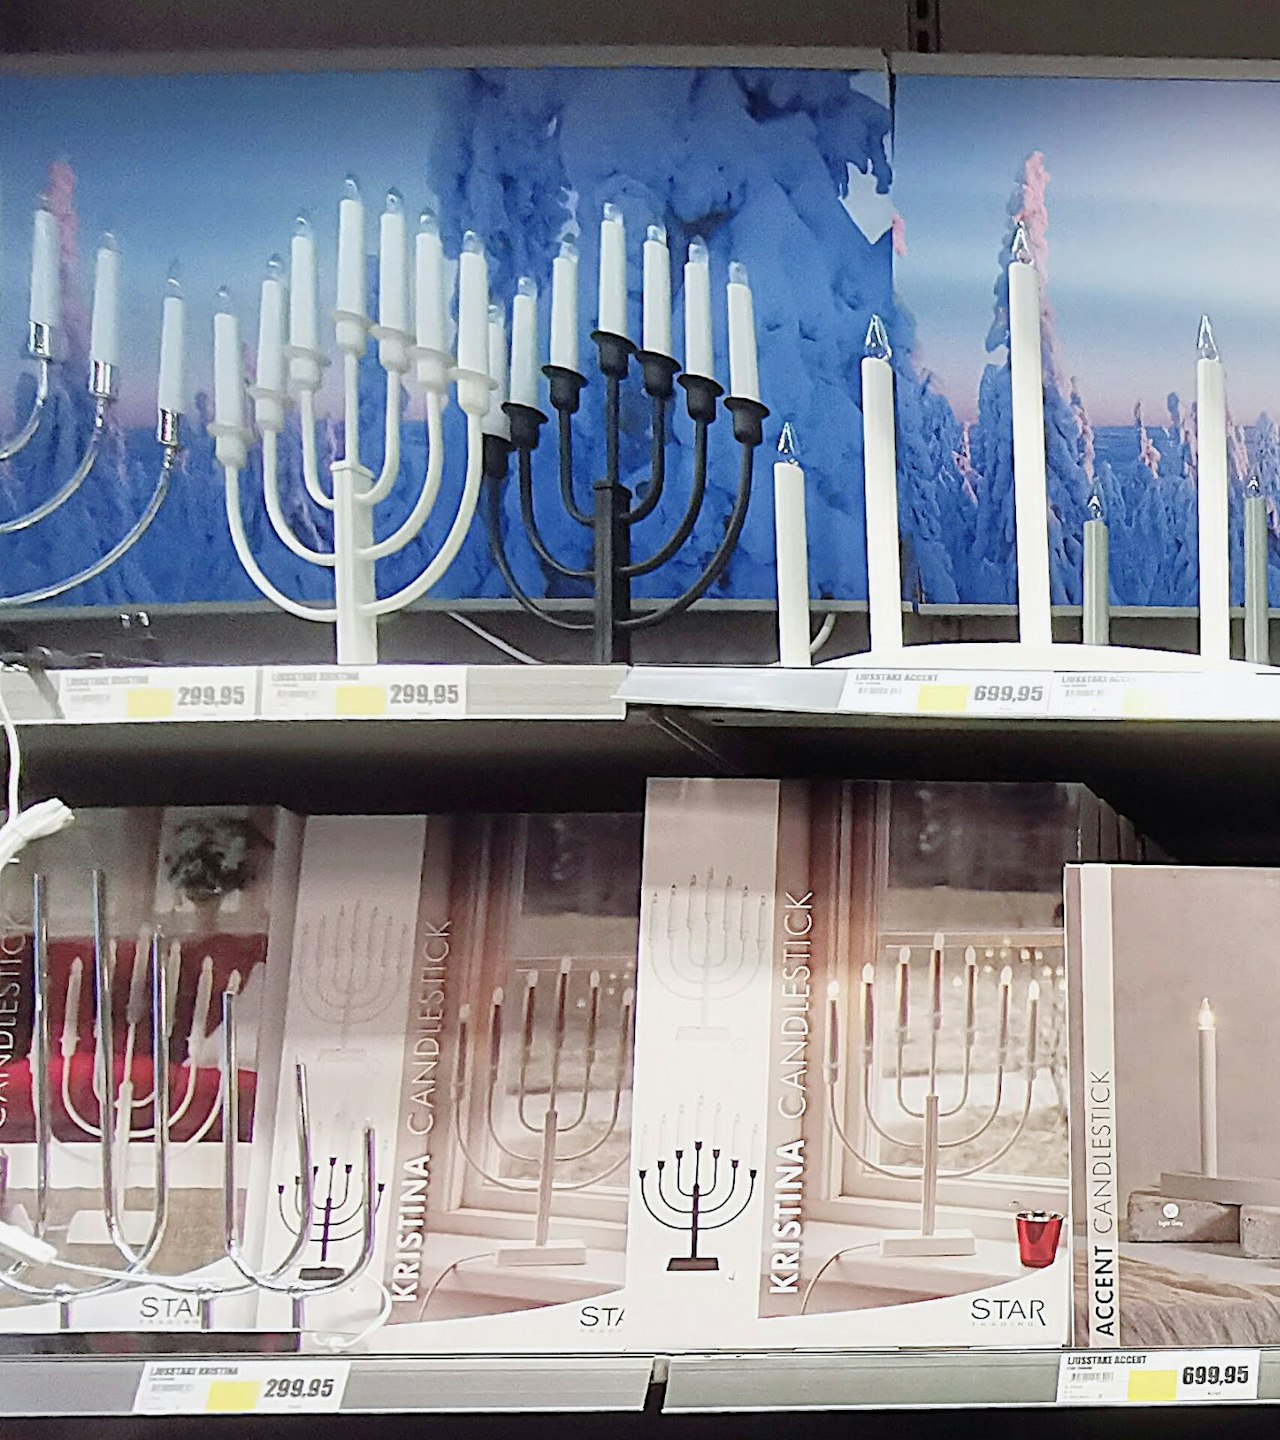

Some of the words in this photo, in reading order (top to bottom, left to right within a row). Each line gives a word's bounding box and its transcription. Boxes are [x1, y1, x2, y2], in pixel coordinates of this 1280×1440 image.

[973, 685, 1043, 702] 699,95
[408, 919, 452, 1136] CANDLESTICK
[779, 890, 814, 1119] CANDLESTICK
[1091, 1069, 1111, 1237] CANDLESTICK
[390, 1153, 430, 1302] KRISTINA
[769, 1138, 805, 1295] KRISTINA
[139, 1297, 203, 1318] STA
[580, 1306, 625, 1327] STA
[971, 1299, 1047, 1327] STAR
[1095, 1244, 1115, 1337] ACCENT
[1114, 1355, 1147, 1364] ACCENT
[1183, 1366, 1249, 1385] 699,95
